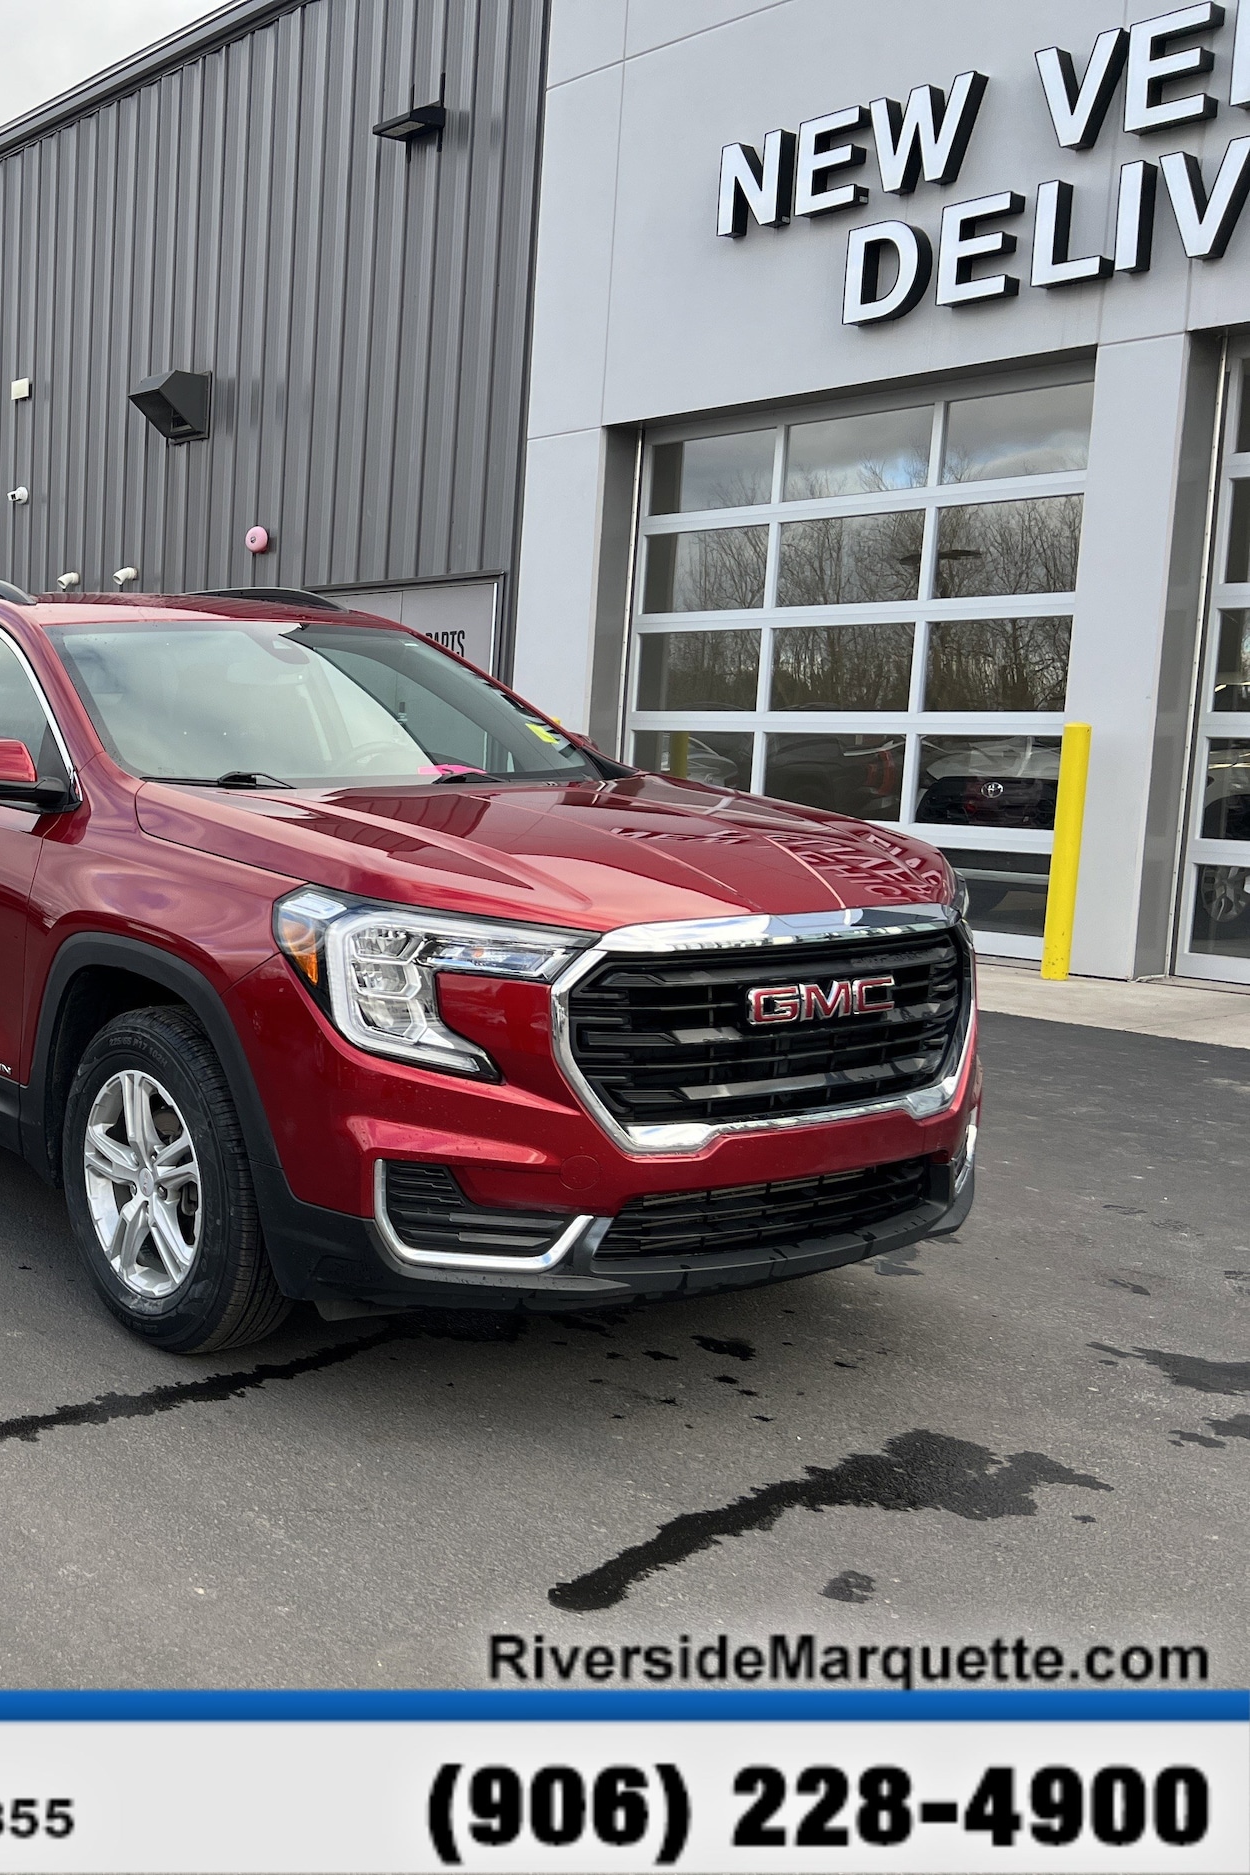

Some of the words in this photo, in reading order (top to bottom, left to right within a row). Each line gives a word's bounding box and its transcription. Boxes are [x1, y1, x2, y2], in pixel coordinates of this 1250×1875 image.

[716, 71, 989, 239] NEW
[1034, 0, 1250, 151] VE
[842, 136, 1250, 325] DELIV
[748, 974, 895, 1027] GMC
